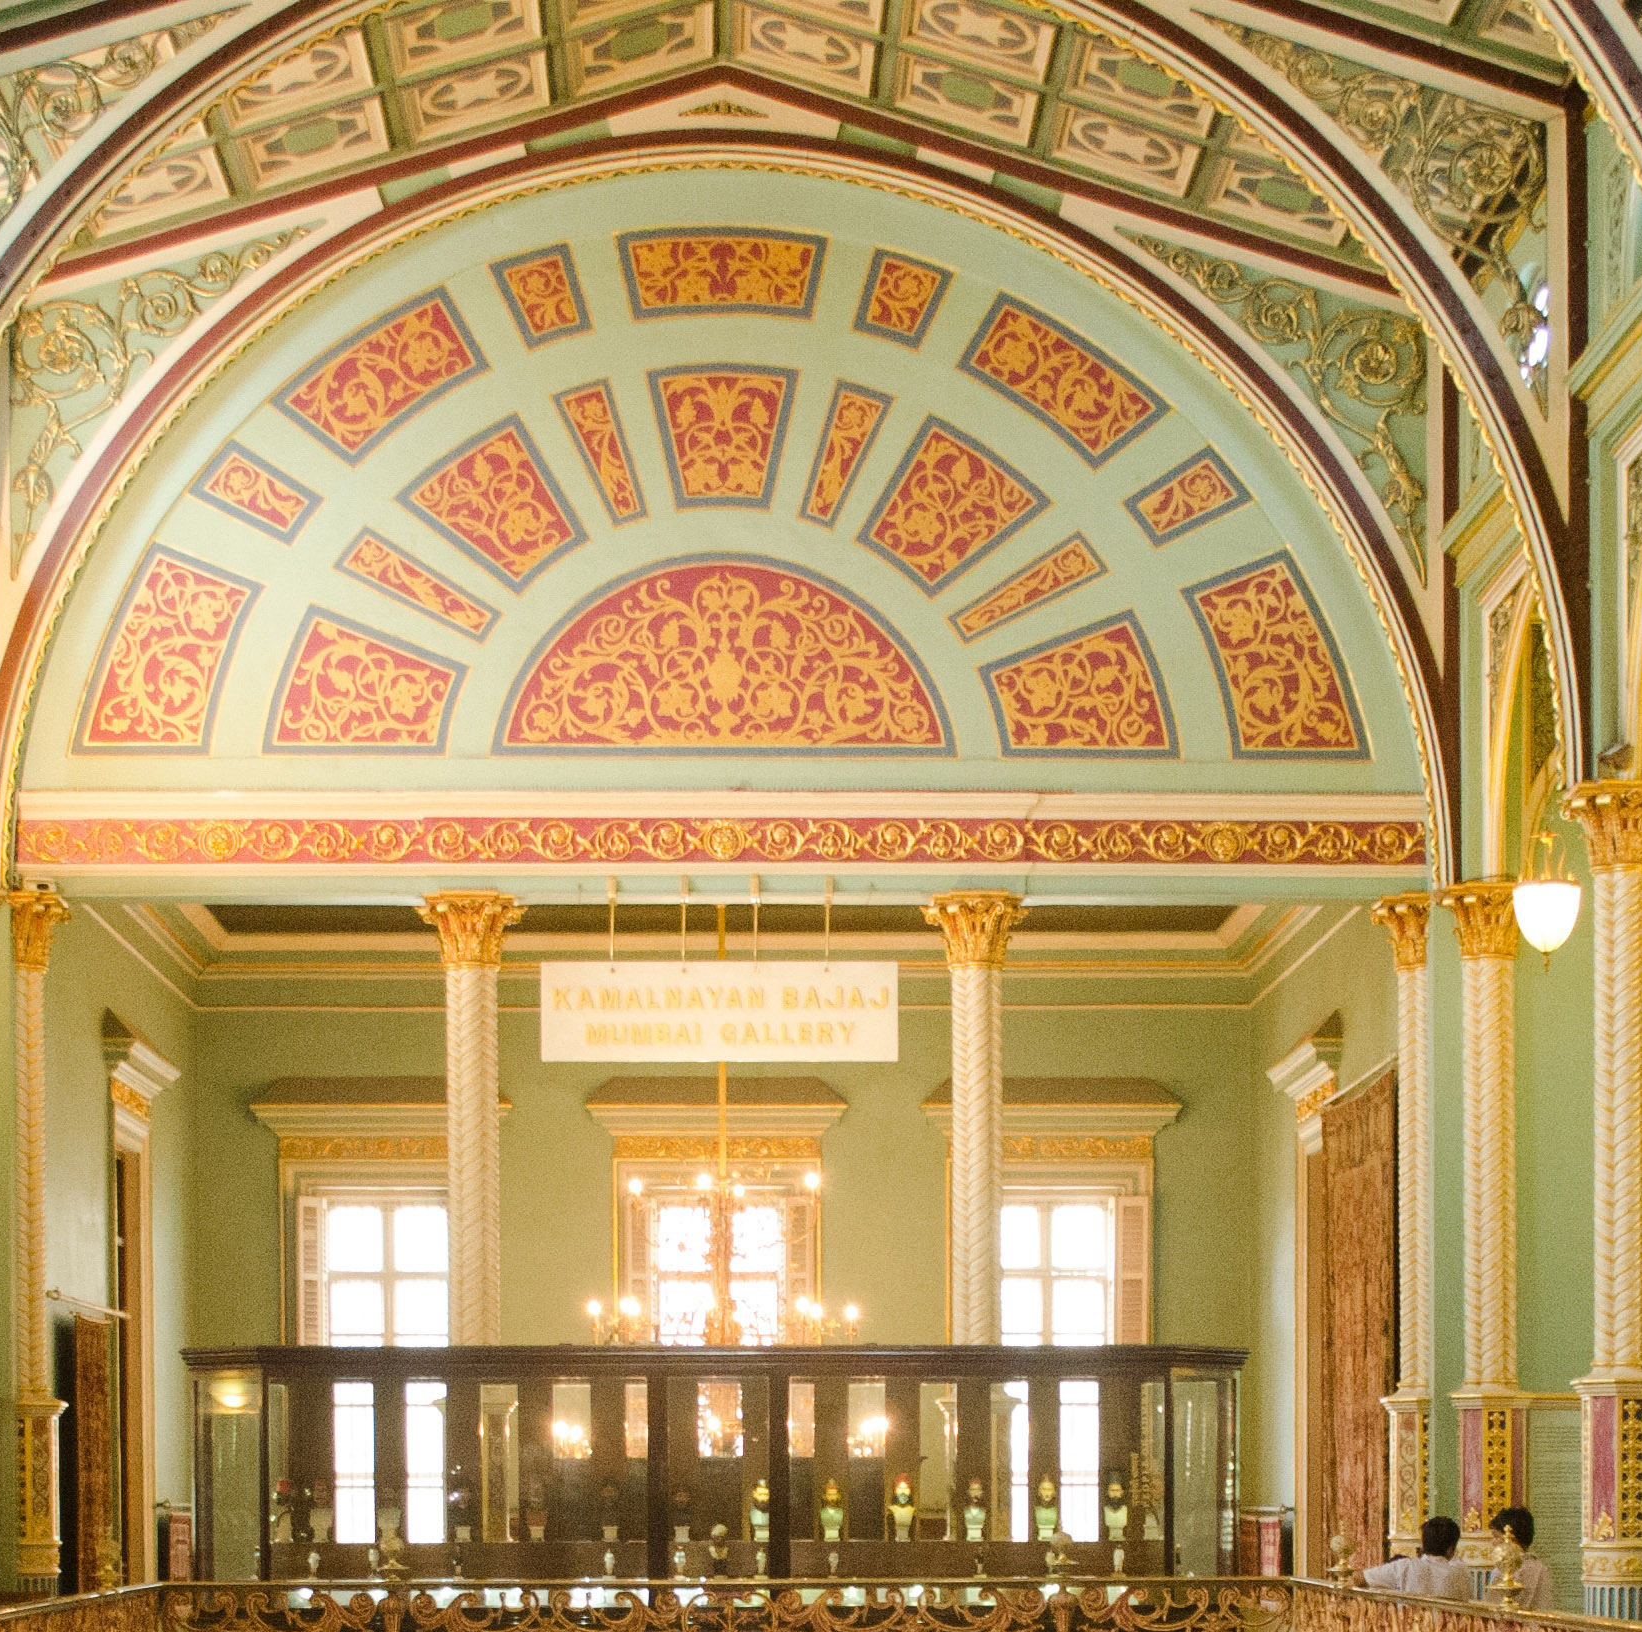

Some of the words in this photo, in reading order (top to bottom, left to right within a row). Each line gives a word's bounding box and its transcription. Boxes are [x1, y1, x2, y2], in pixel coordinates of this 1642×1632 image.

[551, 986, 765, 1010] KAMALNAYAN
[782, 986, 889, 1010] BAJAJ
[585, 1022, 702, 1046] MUMBAI
[719, 1022, 855, 1046] GALLERY
